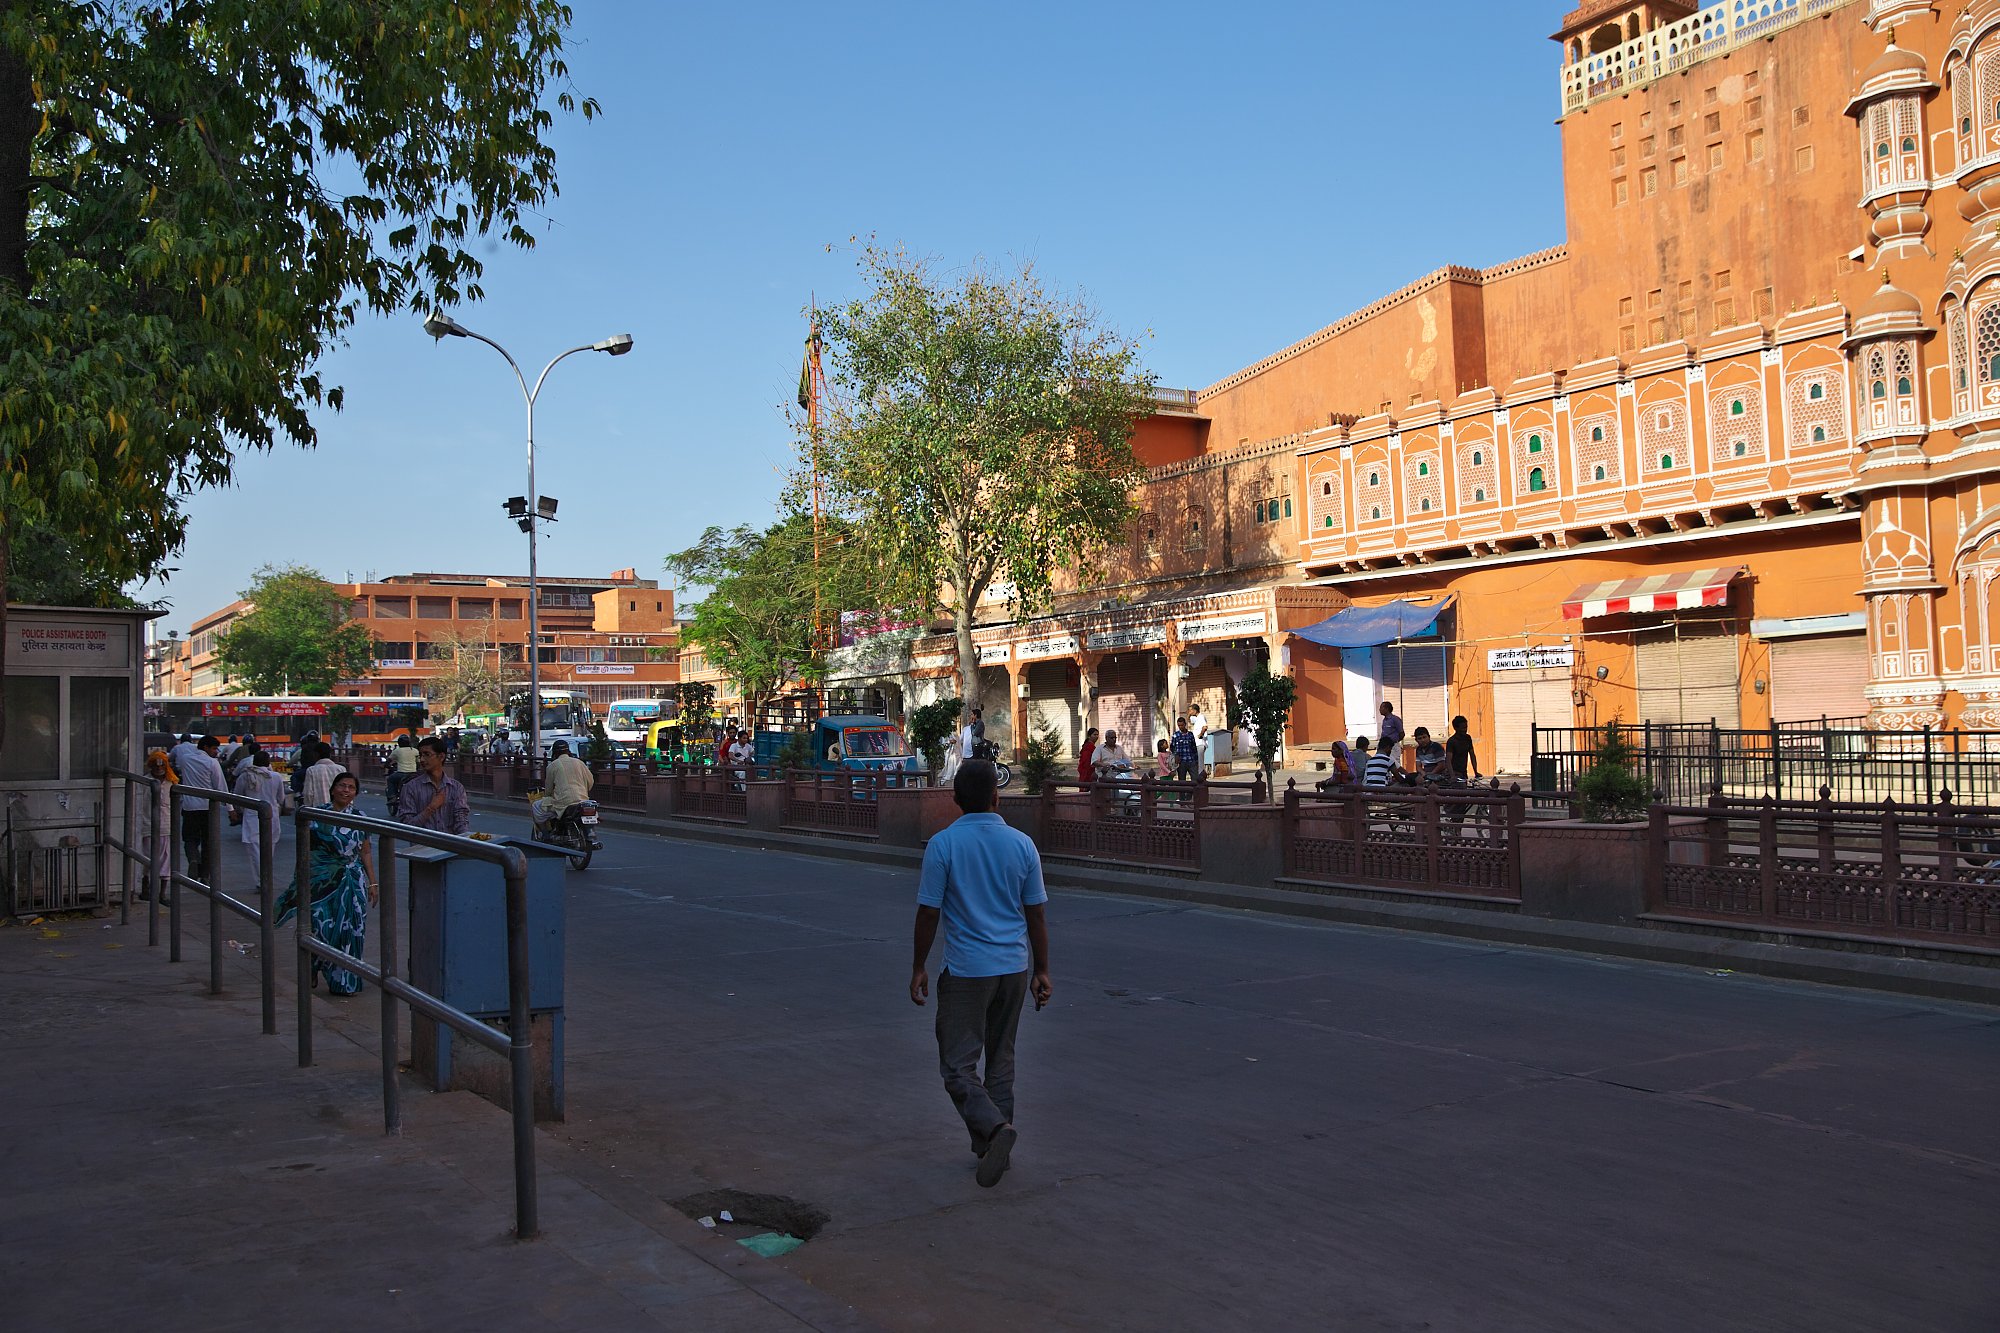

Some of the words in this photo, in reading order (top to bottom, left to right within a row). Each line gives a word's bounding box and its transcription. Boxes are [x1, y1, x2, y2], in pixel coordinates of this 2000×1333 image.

[22, 628, 45, 639] POLICE
[46, 629, 84, 640] ASSISTANCE
[85, 630, 107, 640] BOOTH
[22, 639, 48, 653] पुलिस
[51, 642, 85, 651] सहायता
